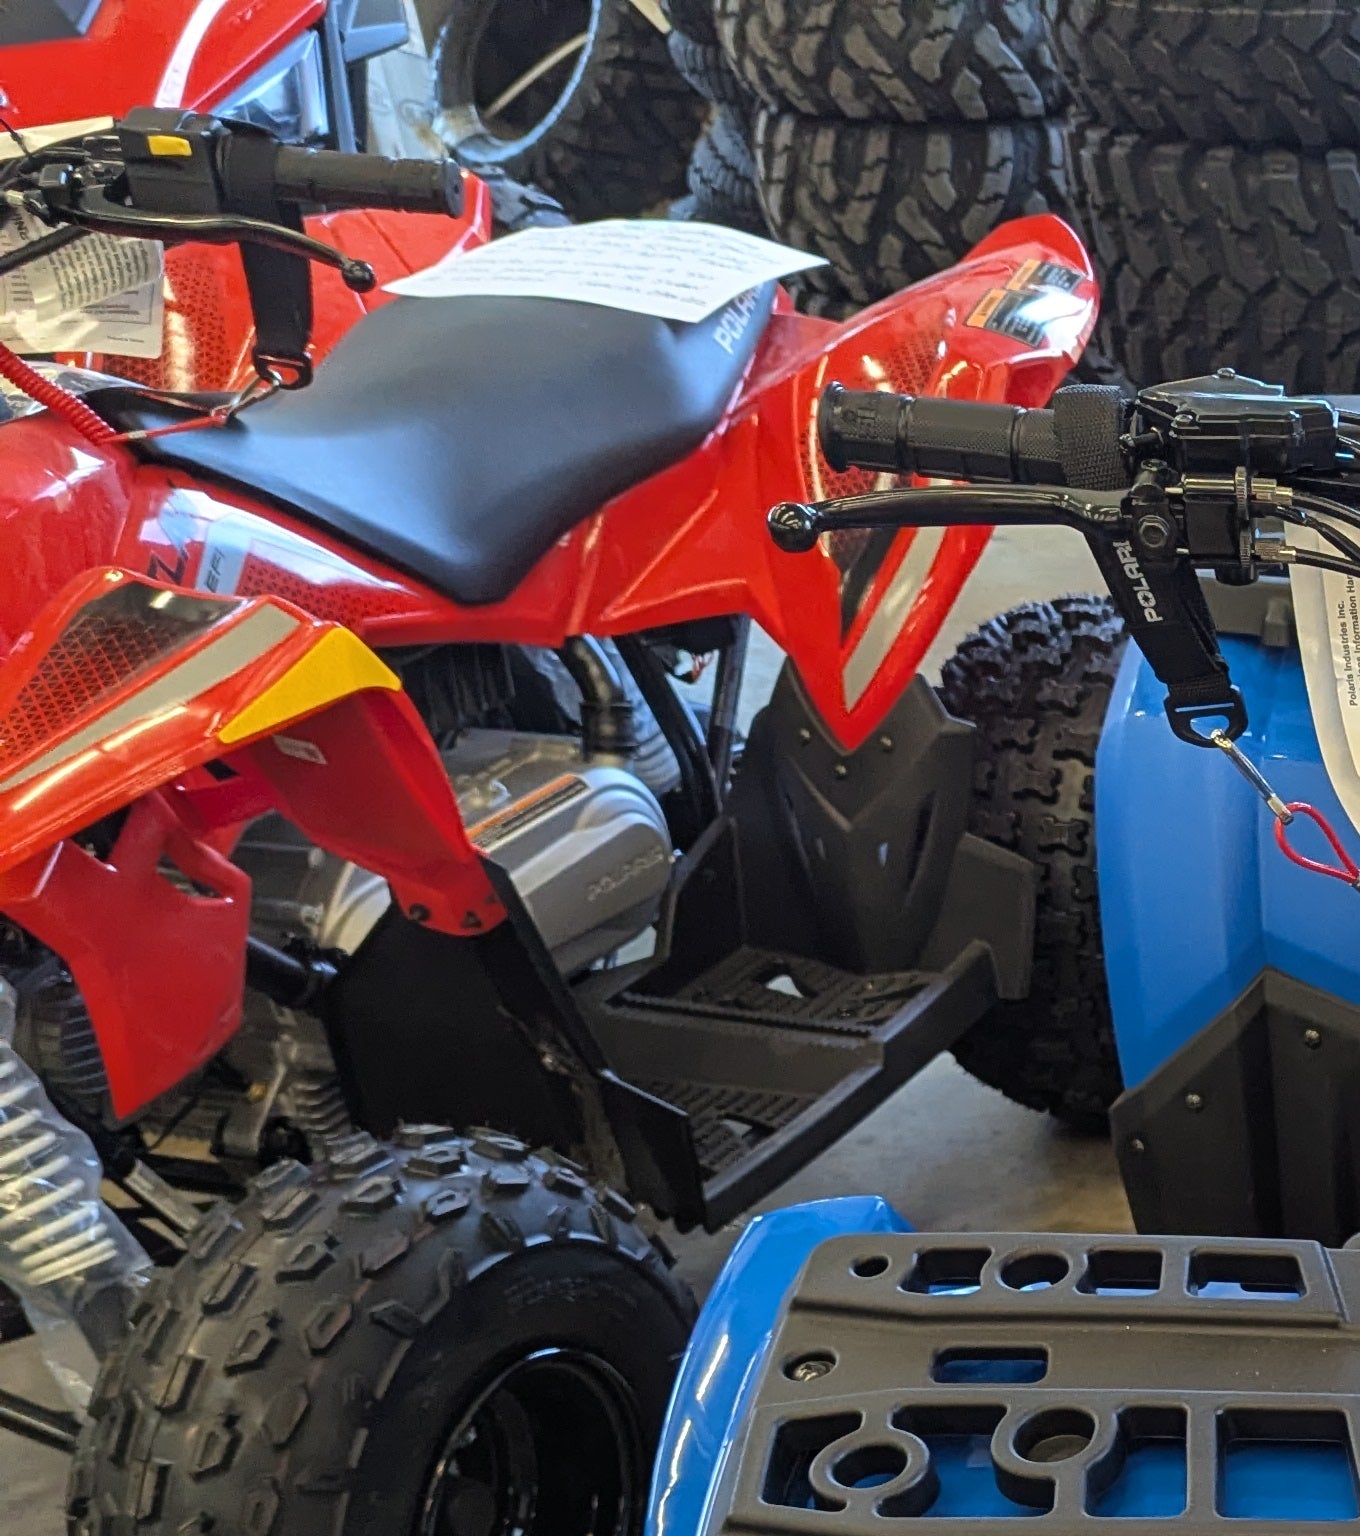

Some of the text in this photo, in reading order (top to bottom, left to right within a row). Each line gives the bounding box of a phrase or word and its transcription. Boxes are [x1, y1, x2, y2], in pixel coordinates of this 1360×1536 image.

[1113, 540, 1161, 623] POLARI
[1337, 601, 1358, 706] Polaris Industries Inc.
[1349, 596, 1360, 653] Information
